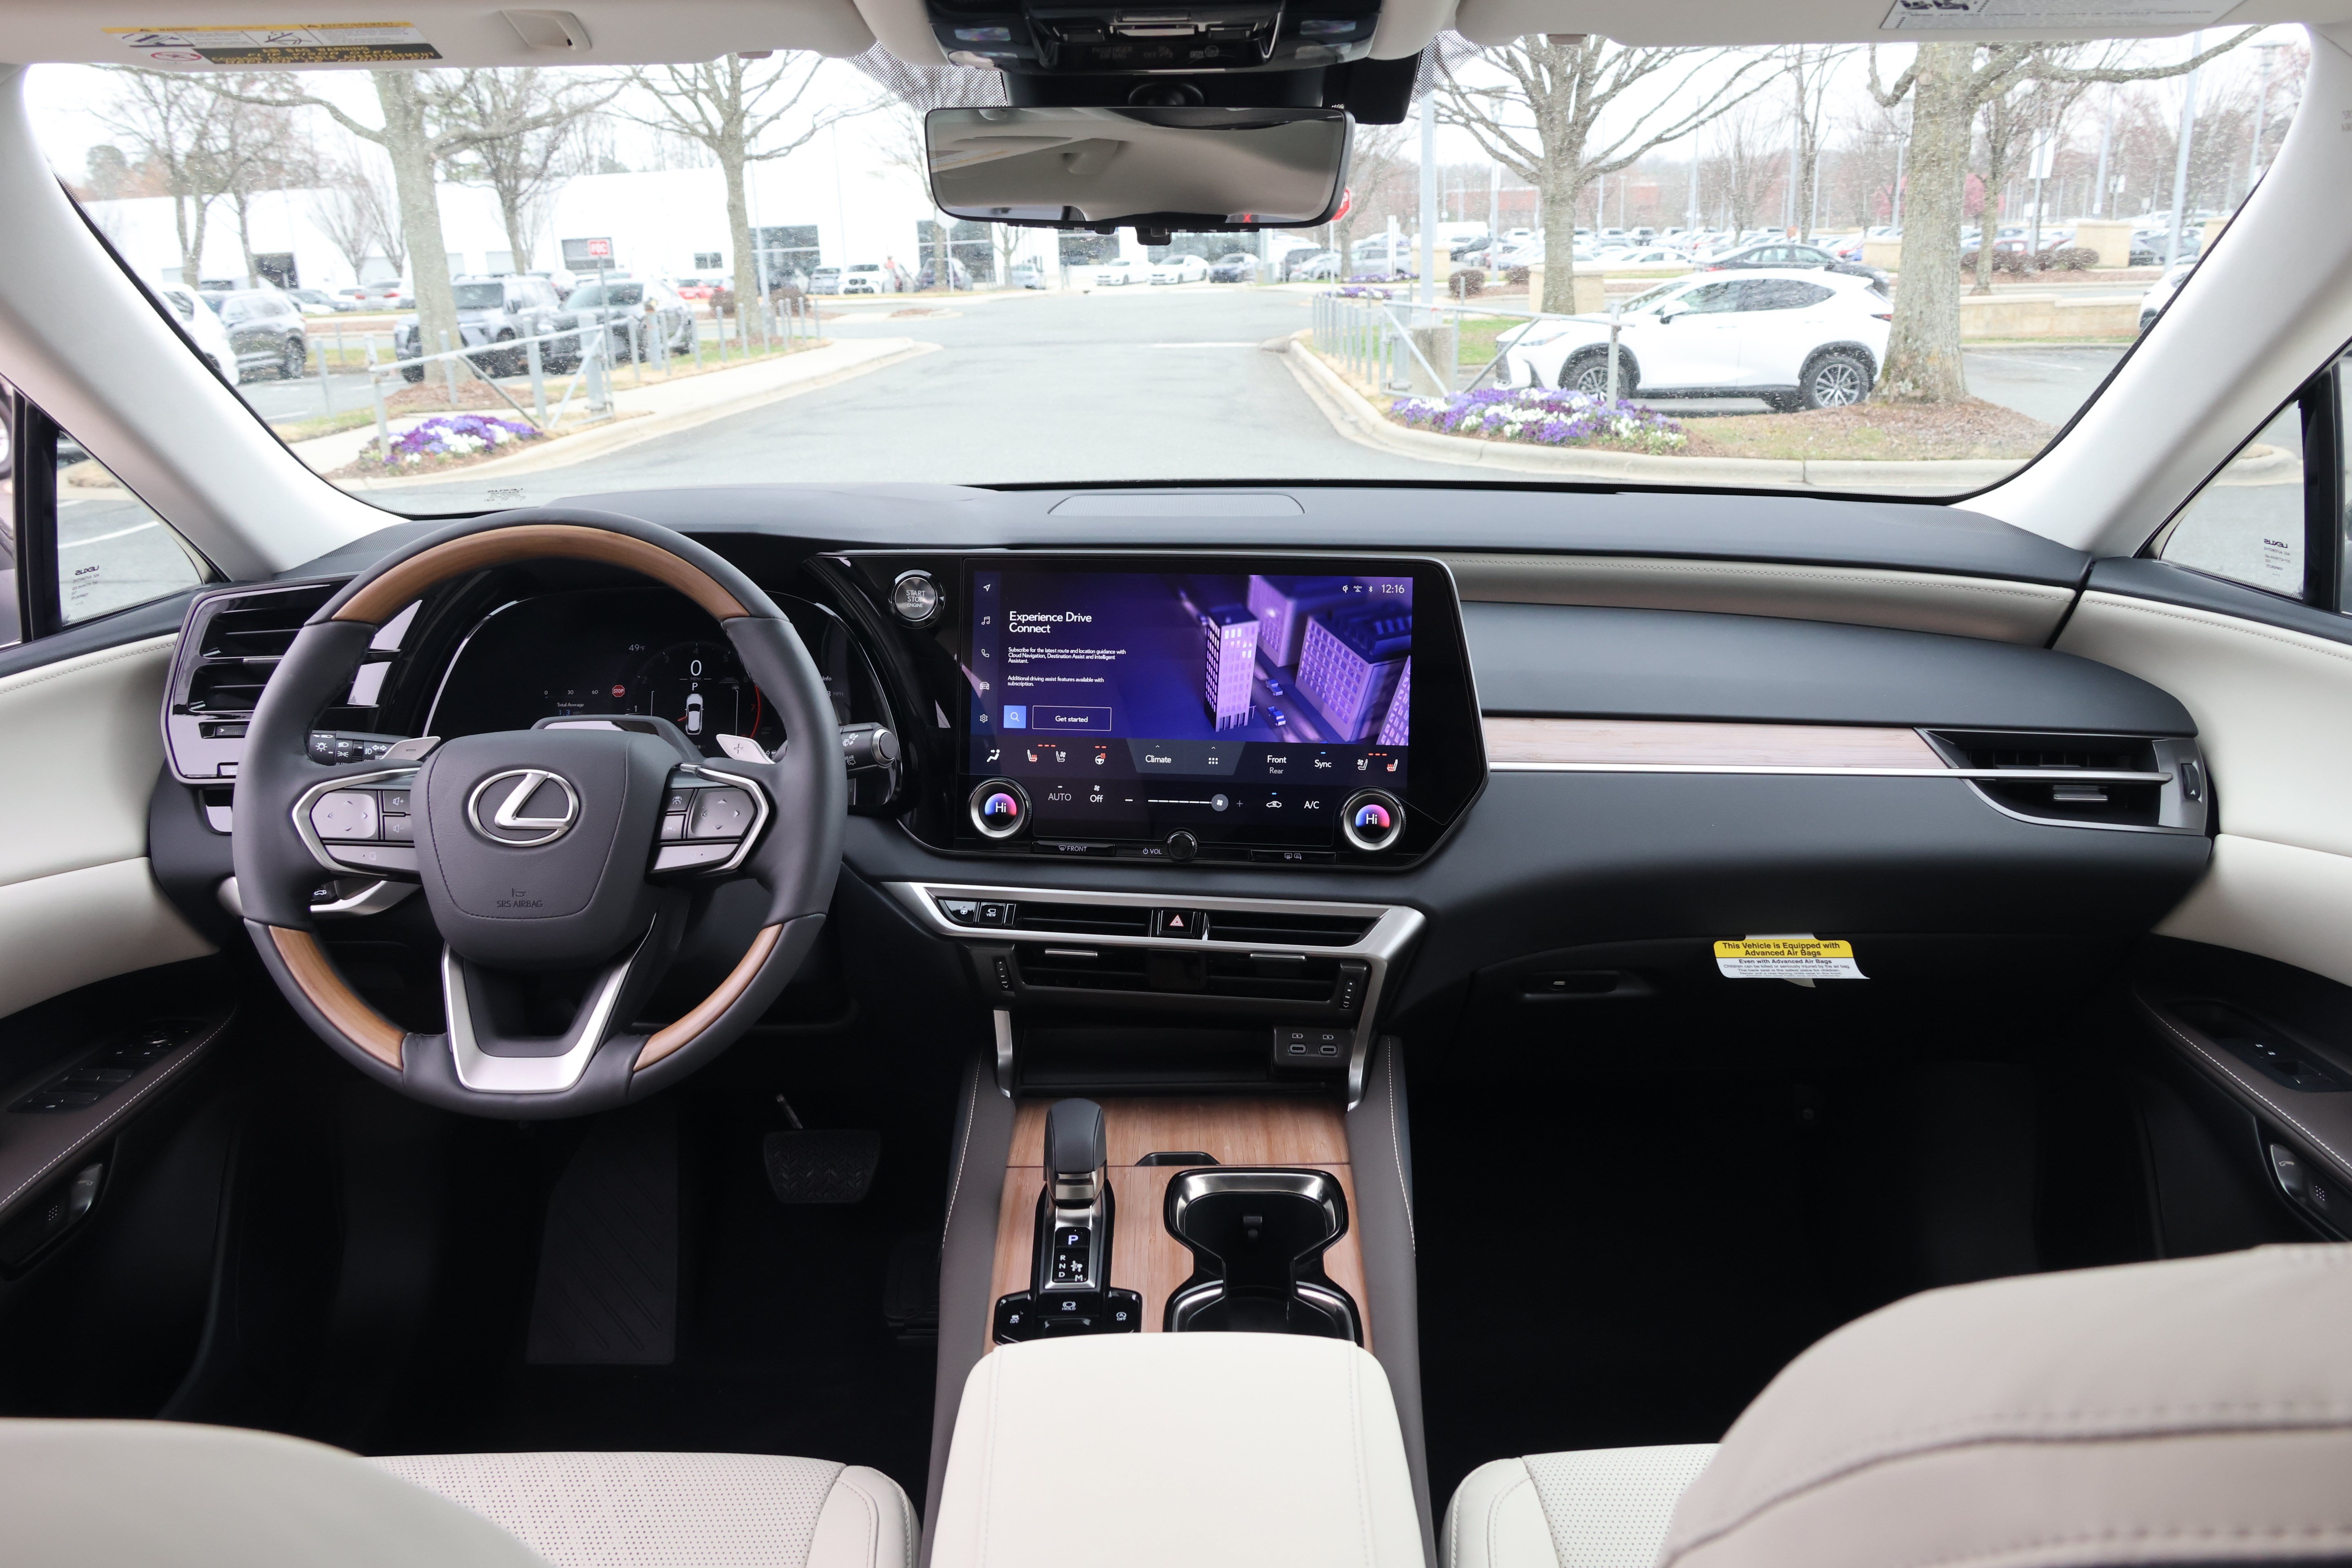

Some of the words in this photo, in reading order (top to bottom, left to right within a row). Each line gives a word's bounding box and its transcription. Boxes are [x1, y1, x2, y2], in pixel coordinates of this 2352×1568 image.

[1381, 584, 1405, 593] 12:16
[1009, 611, 1063, 623] Experience
[1066, 612, 1092, 622] Drive
[1009, 622, 1050, 633] Connect
[690, 660, 702, 676] 0
[692, 683, 698, 691] P
[1145, 755, 1172, 764] Climate
[1267, 755, 1287, 764] Front
[1314, 760, 1332, 768] Sync
[1048, 793, 1071, 801] AUTO
[1090, 795, 1103, 803] Off
[996, 802, 1006, 813] Hi
[1304, 801, 1320, 809] A/C
[1366, 813, 1377, 824] Hi
[1068, 1235, 1079, 1245] P
